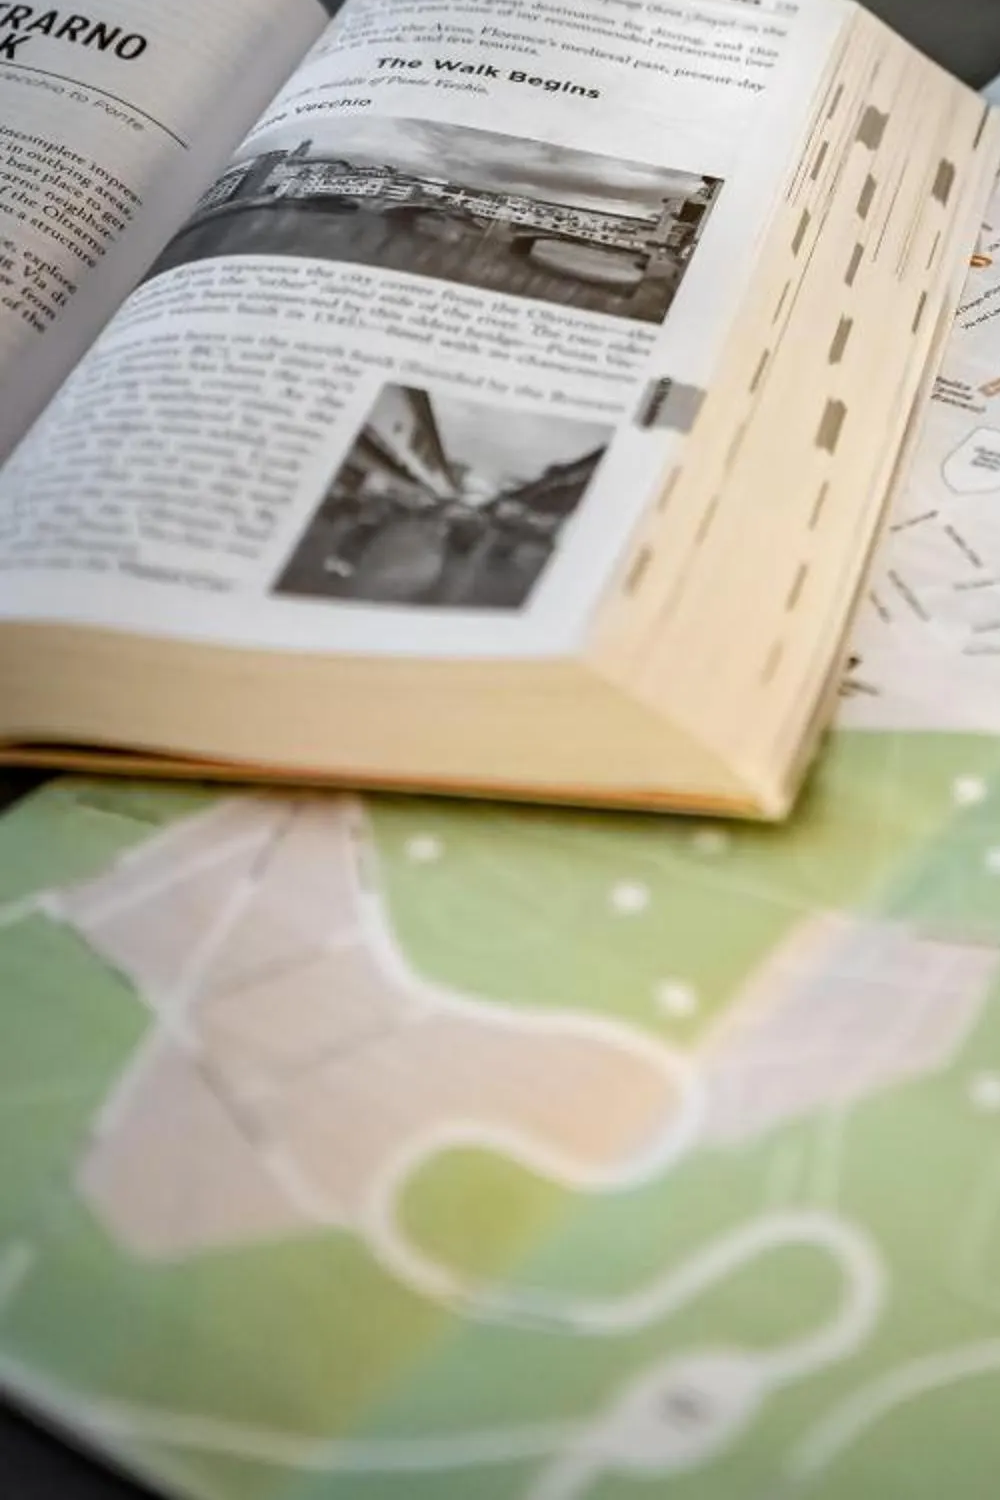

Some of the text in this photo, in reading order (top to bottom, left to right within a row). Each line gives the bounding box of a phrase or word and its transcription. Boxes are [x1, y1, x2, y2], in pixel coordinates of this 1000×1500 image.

[375, 57, 601, 99] The Walk Begins
[26, 151, 93, 189] outlying
[29, 217, 97, 269] structure
[43, 204, 107, 256] Oltrarno
